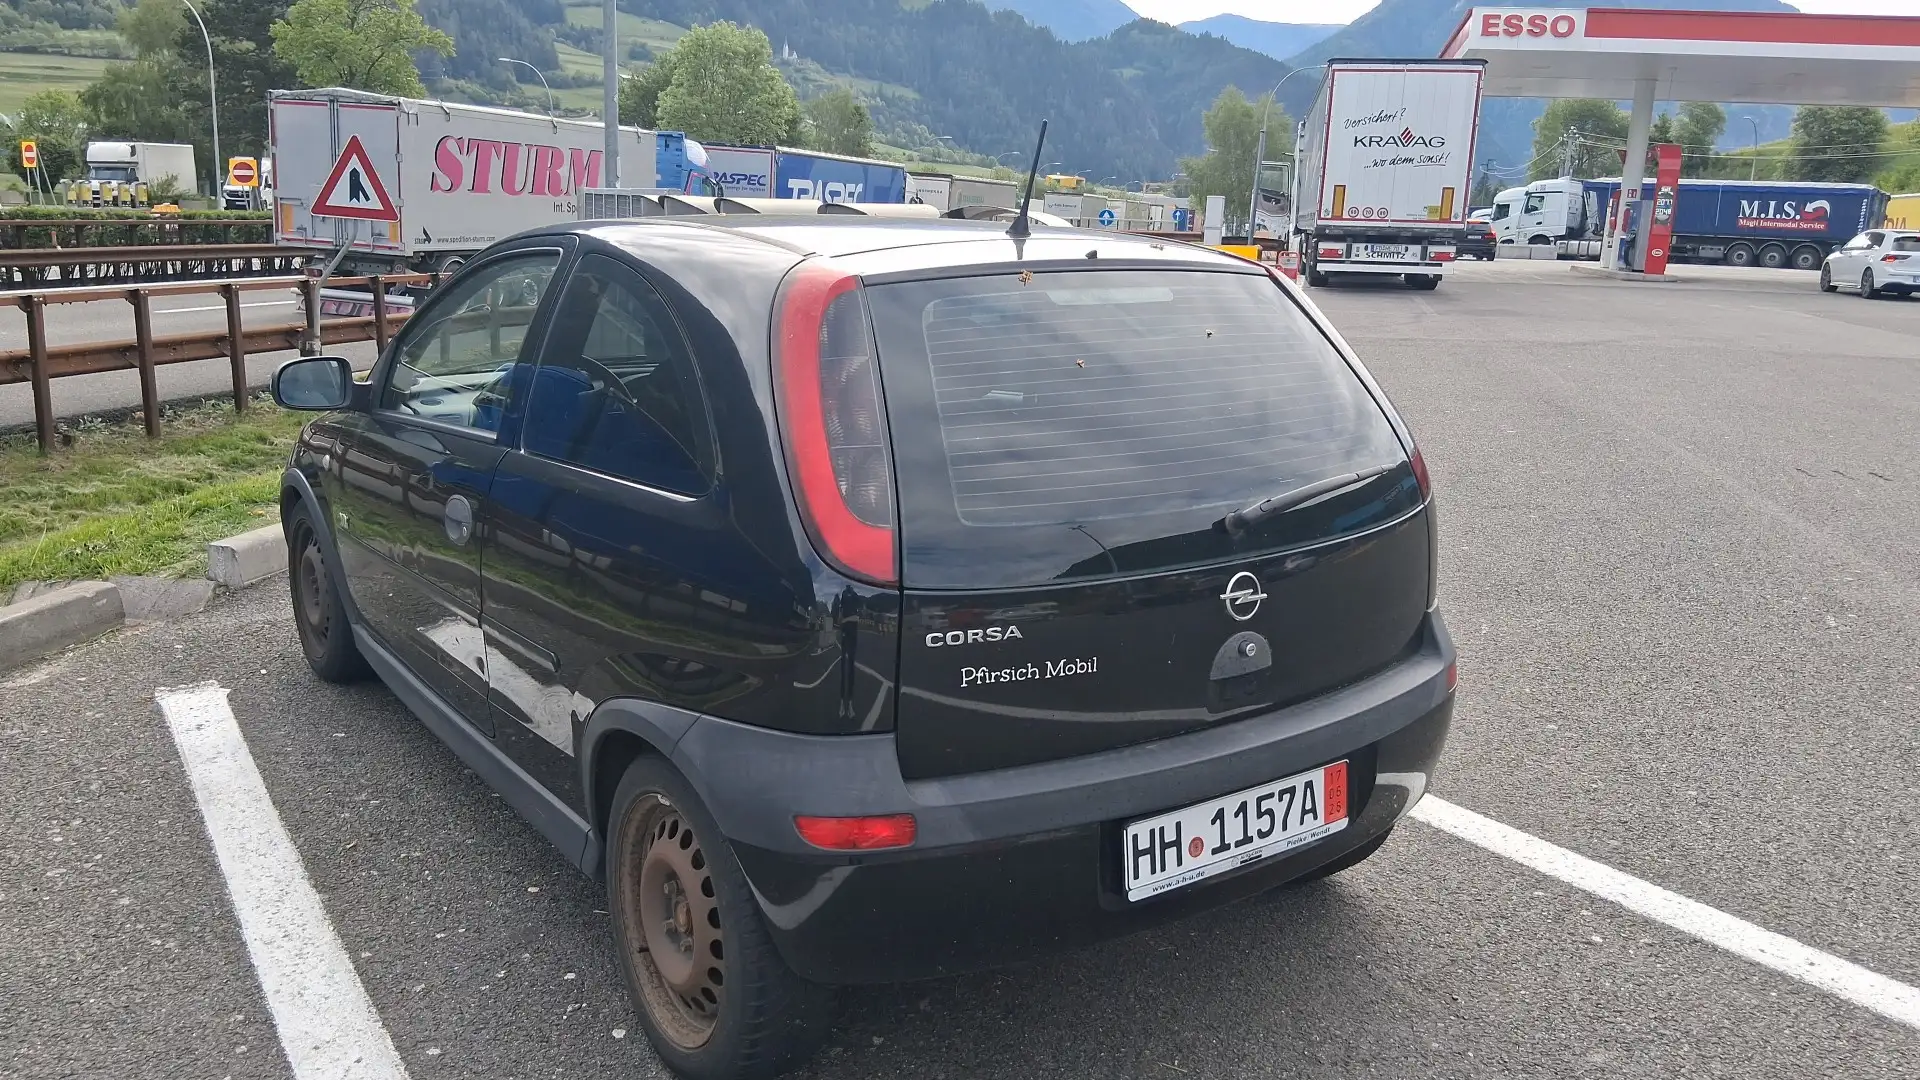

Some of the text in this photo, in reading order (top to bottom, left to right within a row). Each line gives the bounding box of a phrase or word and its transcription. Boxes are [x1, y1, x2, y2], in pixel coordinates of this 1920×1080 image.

[1480, 13, 1576, 38] ESSO
[1353, 135, 1446, 148] KRAVAG
[430, 134, 604, 198] STURM
[1388, 154, 1415, 166] denn
[713, 171, 767, 187] RASPEC
[553, 201, 566, 213] Int.
[1738, 199, 1801, 220] M.I.S.
[1760, 219, 1799, 229] Intermodal
[1799, 221, 1825, 230] Service
[1365, 251, 1406, 260] SCHMITZ
[925, 625, 1023, 648] CORSA
[960, 656, 1098, 688] Pfirsich Mobil
[1330, 768, 1342, 786] 17
[1131, 779, 1319, 881] HH 1157A
